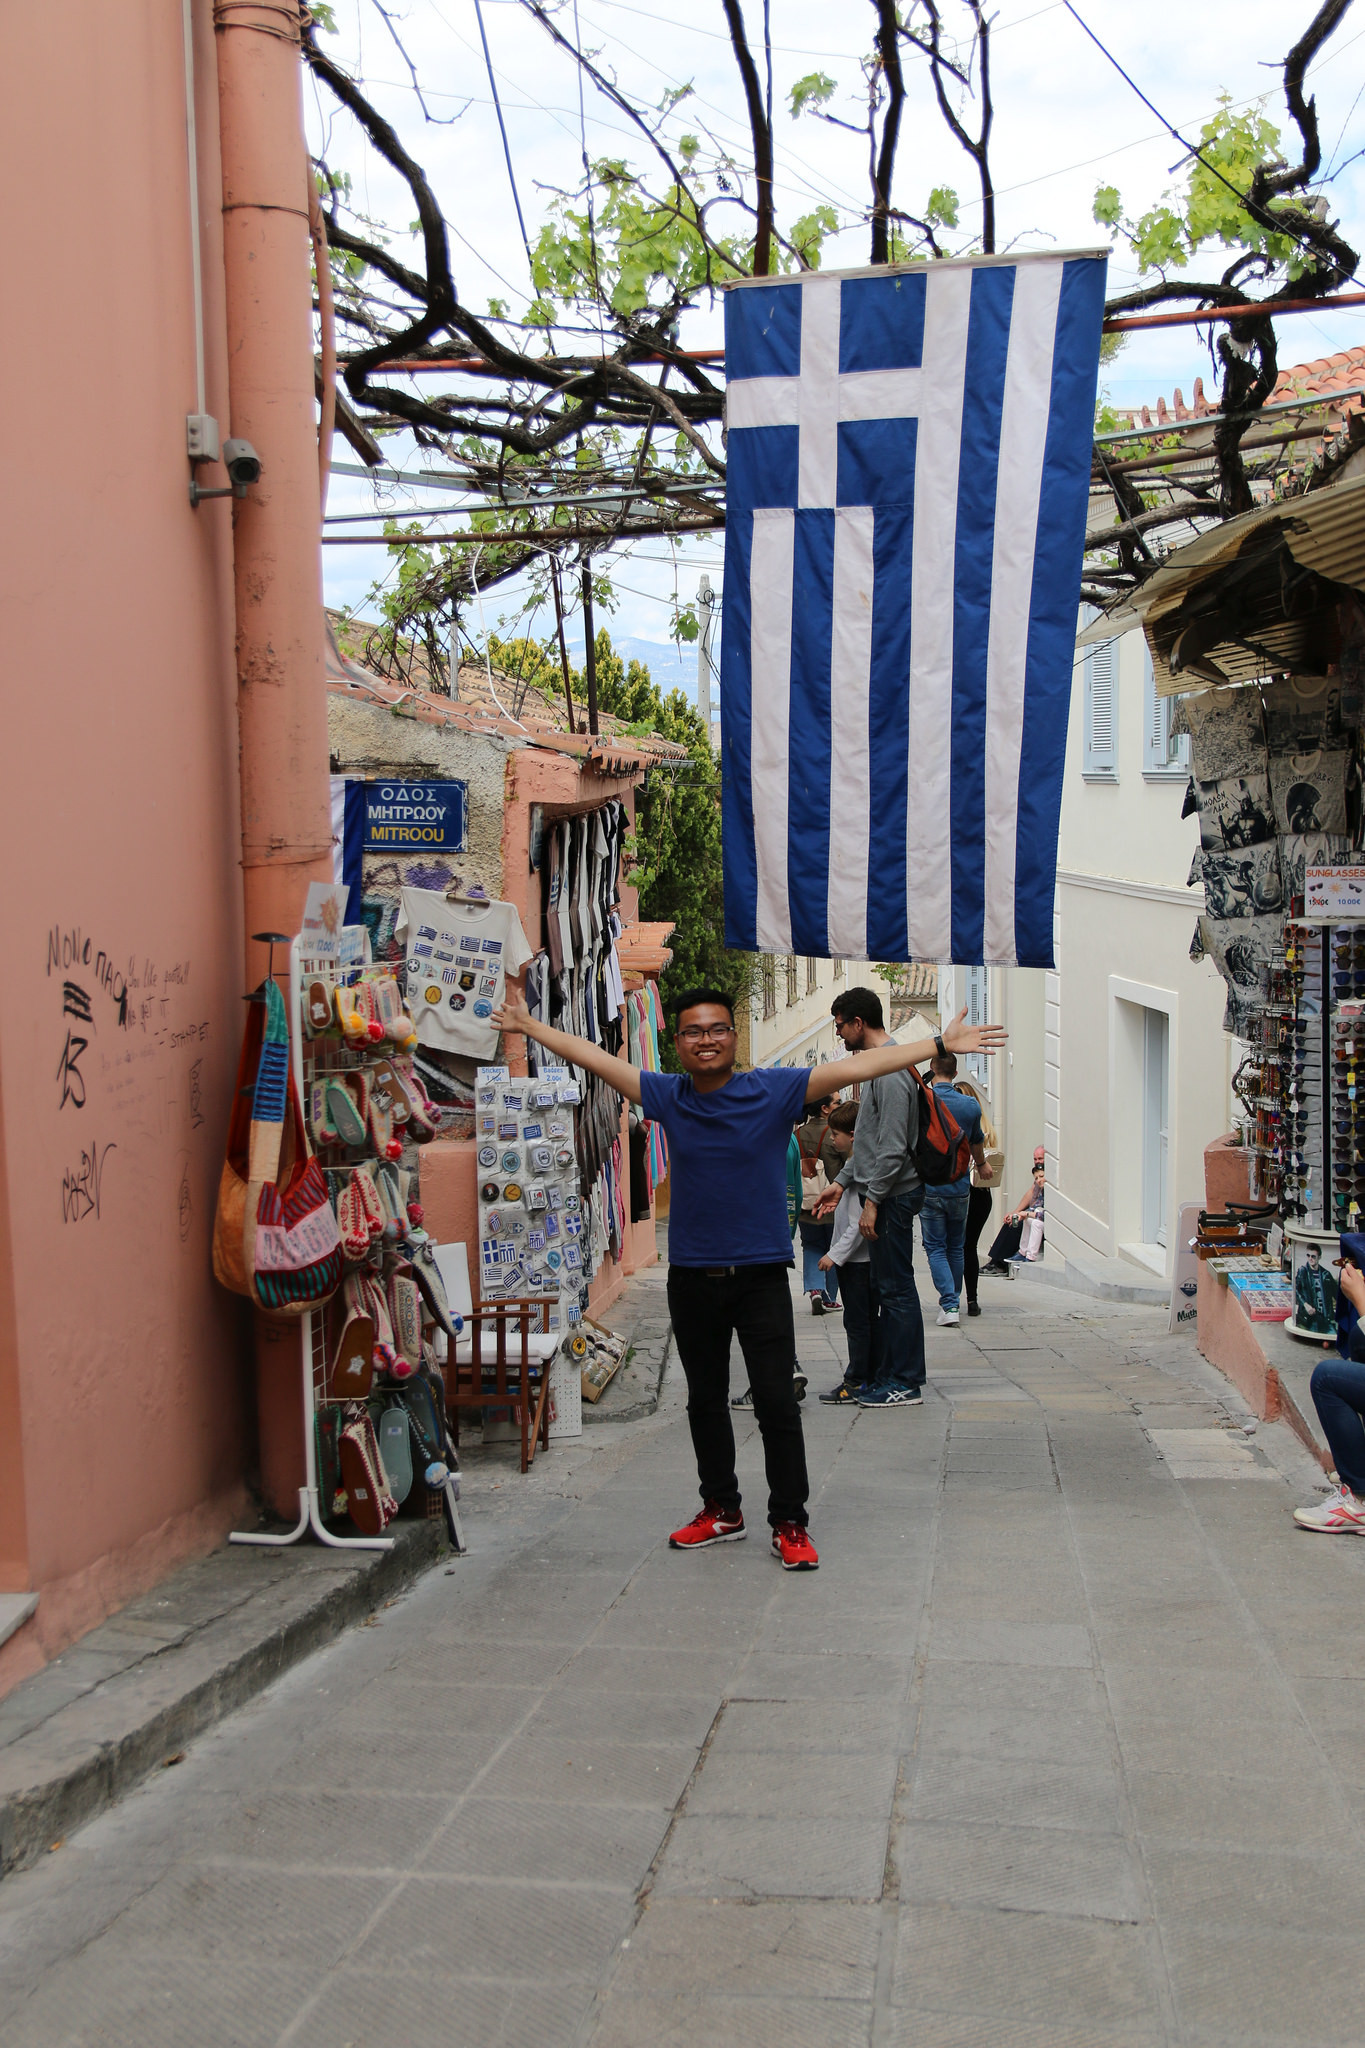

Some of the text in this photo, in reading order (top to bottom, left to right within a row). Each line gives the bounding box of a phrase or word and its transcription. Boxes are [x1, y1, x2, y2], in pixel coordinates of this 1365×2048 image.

[381, 787, 437, 802] ΟΔΟΣ
[368, 805, 447, 820] ΜΗΤΡΩΟΥ
[371, 826, 445, 842] MITROOU
[1306, 868, 1365, 878] SUNGLASSES
